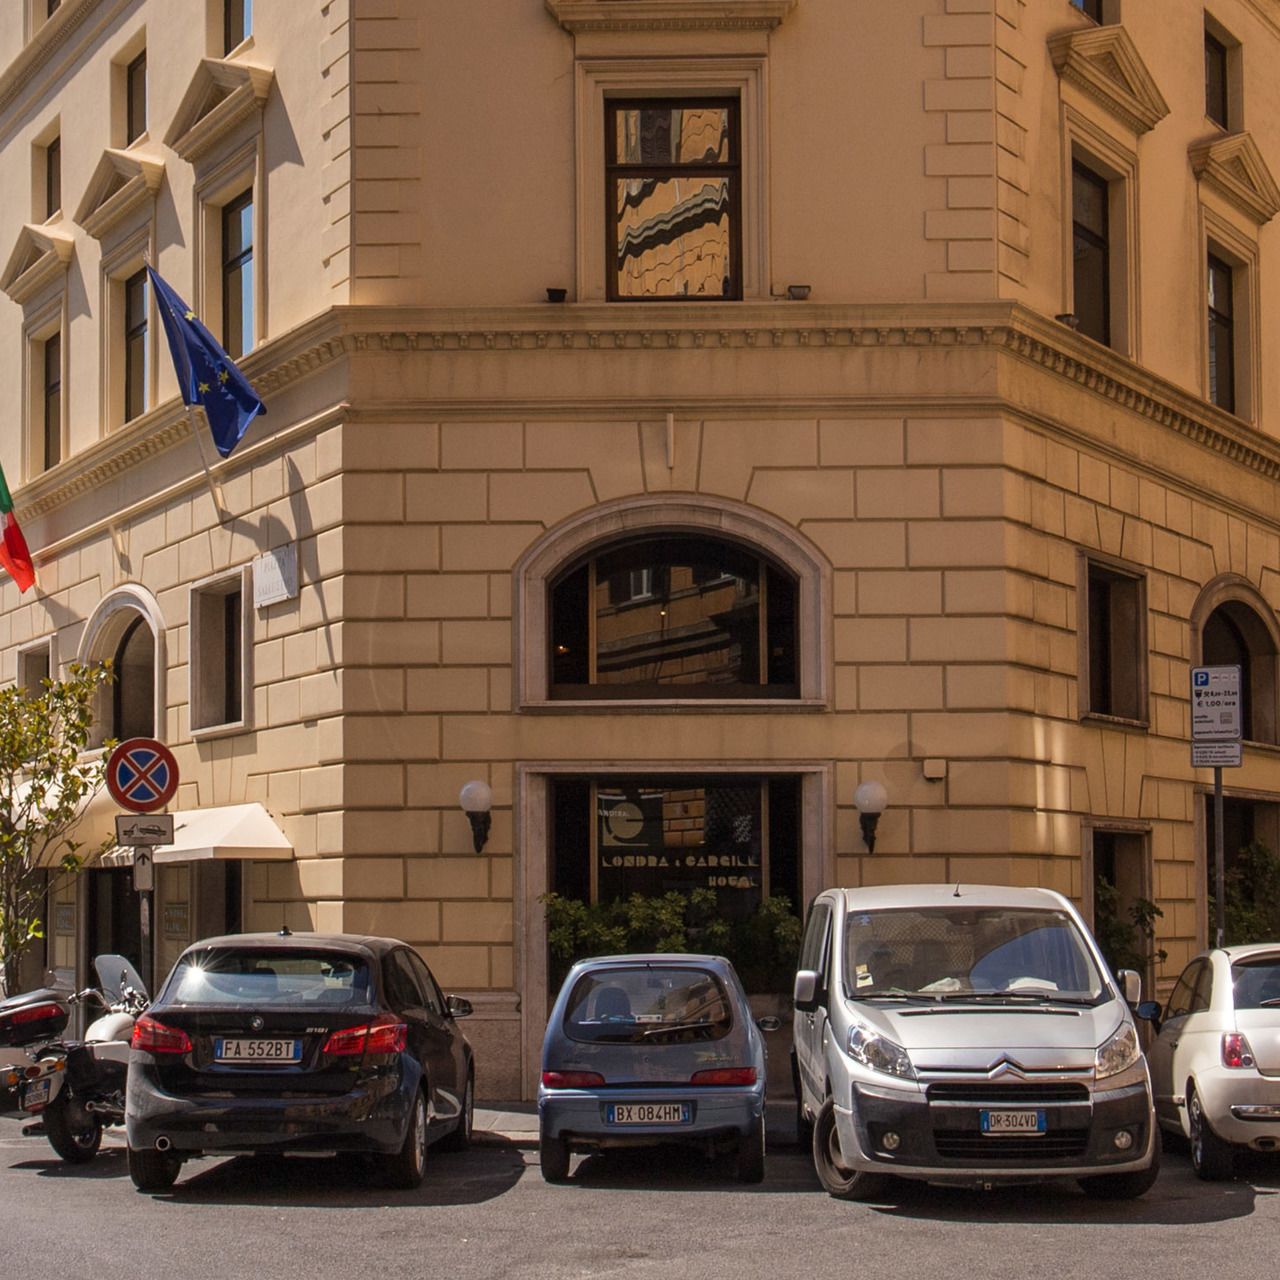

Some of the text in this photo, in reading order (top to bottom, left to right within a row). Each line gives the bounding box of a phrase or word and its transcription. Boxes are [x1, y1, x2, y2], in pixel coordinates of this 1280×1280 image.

[1197, 673, 1206, 687] P
[602, 856, 669, 867] LONDRA
[685, 856, 760, 867] CARGILL
[224, 1041, 292, 1057] FA 552BT
[616, 1106, 682, 1121] BX 084HM
[990, 1114, 1037, 1128] DR 304VD
